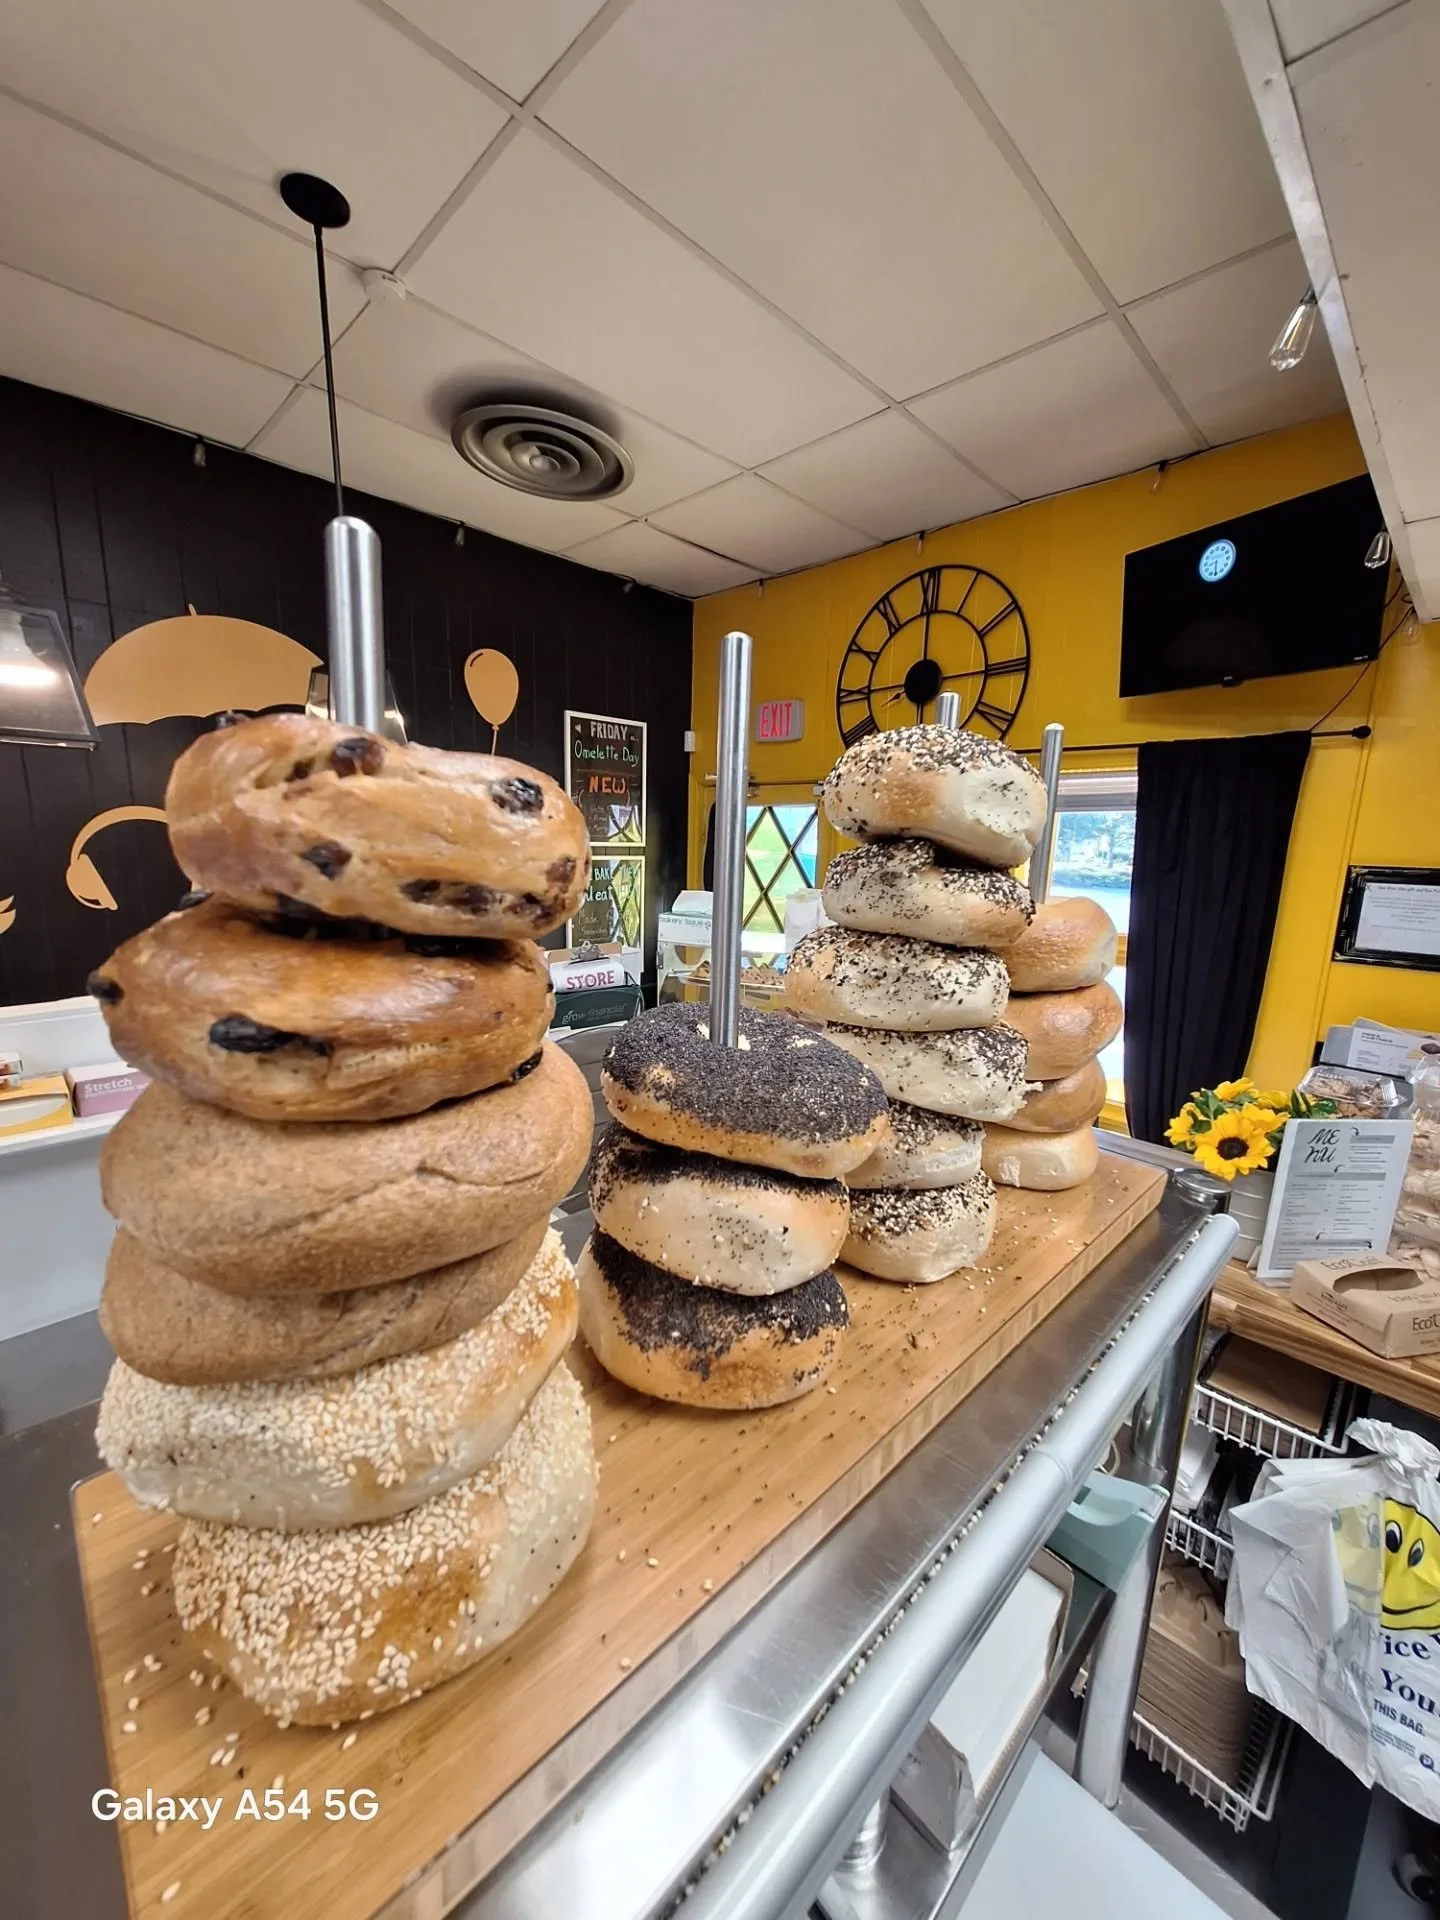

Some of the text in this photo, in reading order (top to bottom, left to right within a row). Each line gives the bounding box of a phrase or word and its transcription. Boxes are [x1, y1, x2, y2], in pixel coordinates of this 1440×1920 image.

[761, 703, 792, 737] EXIT
[590, 721, 628, 740] FRIDAY
[574, 740, 639, 767] Omelette Day
[589, 775, 626, 794] NEW
[594, 866, 614, 881] BAKE
[595, 885, 613, 901] eat
[566, 969, 615, 990] STORE
[85, 1078, 132, 1093] Stretch
[1381, 1632, 1431, 1660] ice
[1373, 1698, 1426, 1737] THIS BAG.
